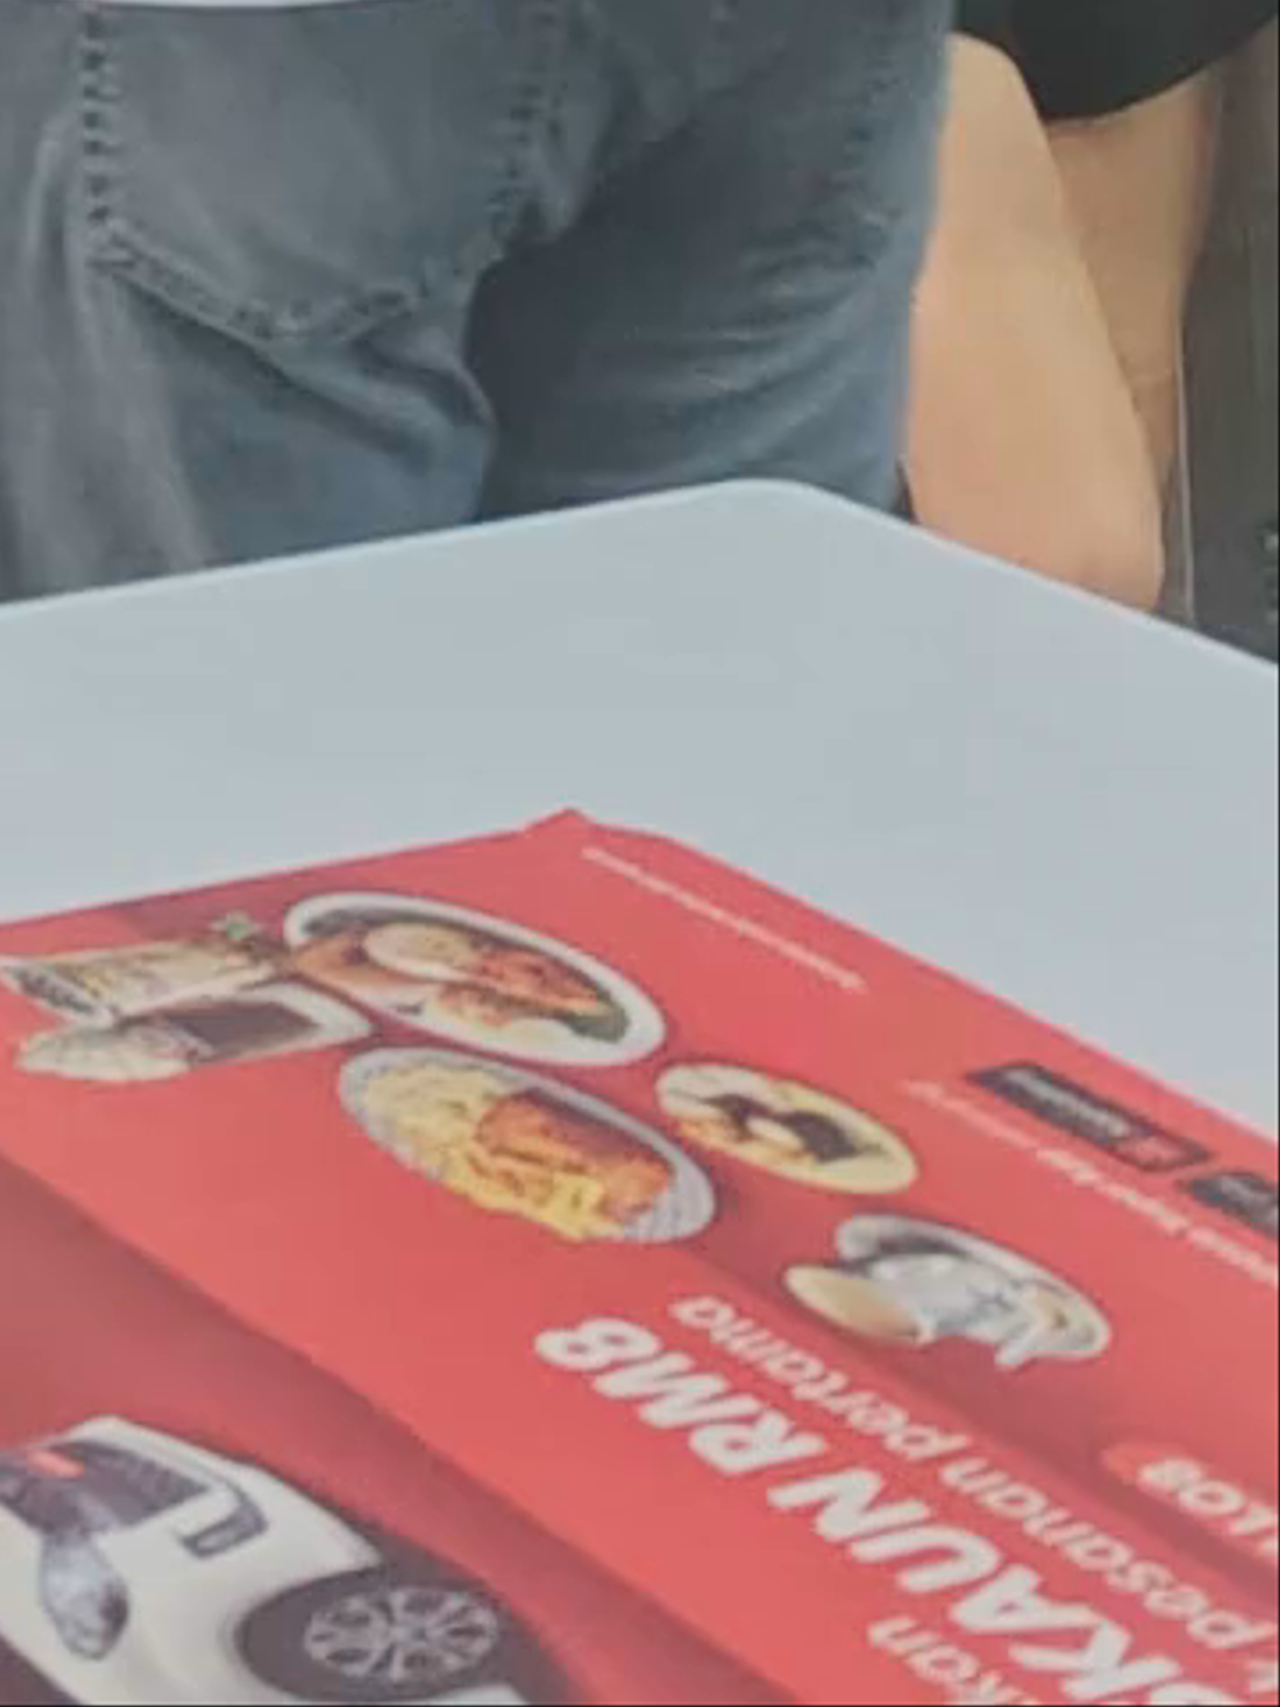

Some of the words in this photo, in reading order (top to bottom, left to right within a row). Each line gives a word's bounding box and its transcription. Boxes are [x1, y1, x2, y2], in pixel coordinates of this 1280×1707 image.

[532, 1317, 828, 1477] RM8
[669, 1293, 970, 1462] pertama
[938, 1457, 1276, 1650] pesanan
